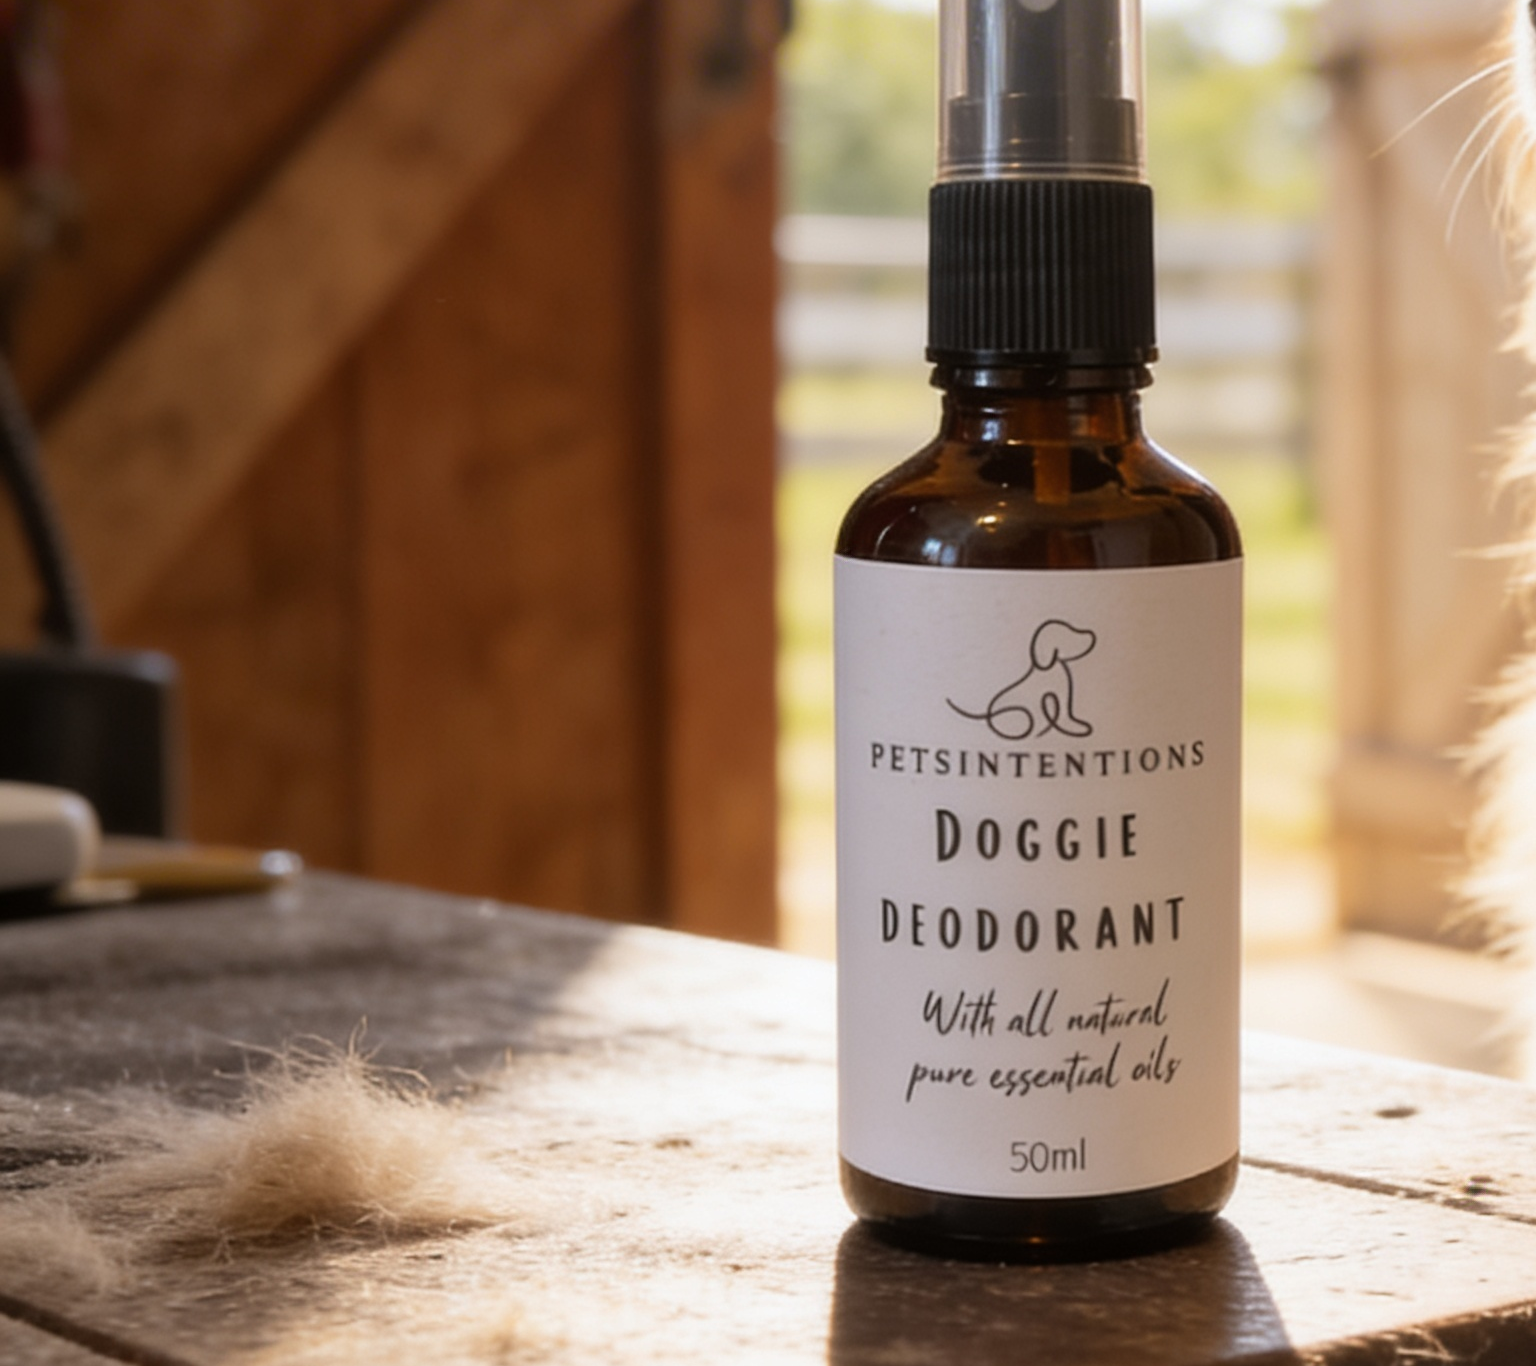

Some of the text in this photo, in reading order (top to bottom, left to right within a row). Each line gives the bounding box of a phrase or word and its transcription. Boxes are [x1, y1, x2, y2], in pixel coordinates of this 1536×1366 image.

[870, 739, 1205, 779] PETSINTENTIONS
[881, 895, 1186, 954] DEODORANT
[922, 976, 1172, 1039] With all natural
[904, 1034, 1182, 1104] pure essential oils
[1009, 1137, 1087, 1174] 50ml
